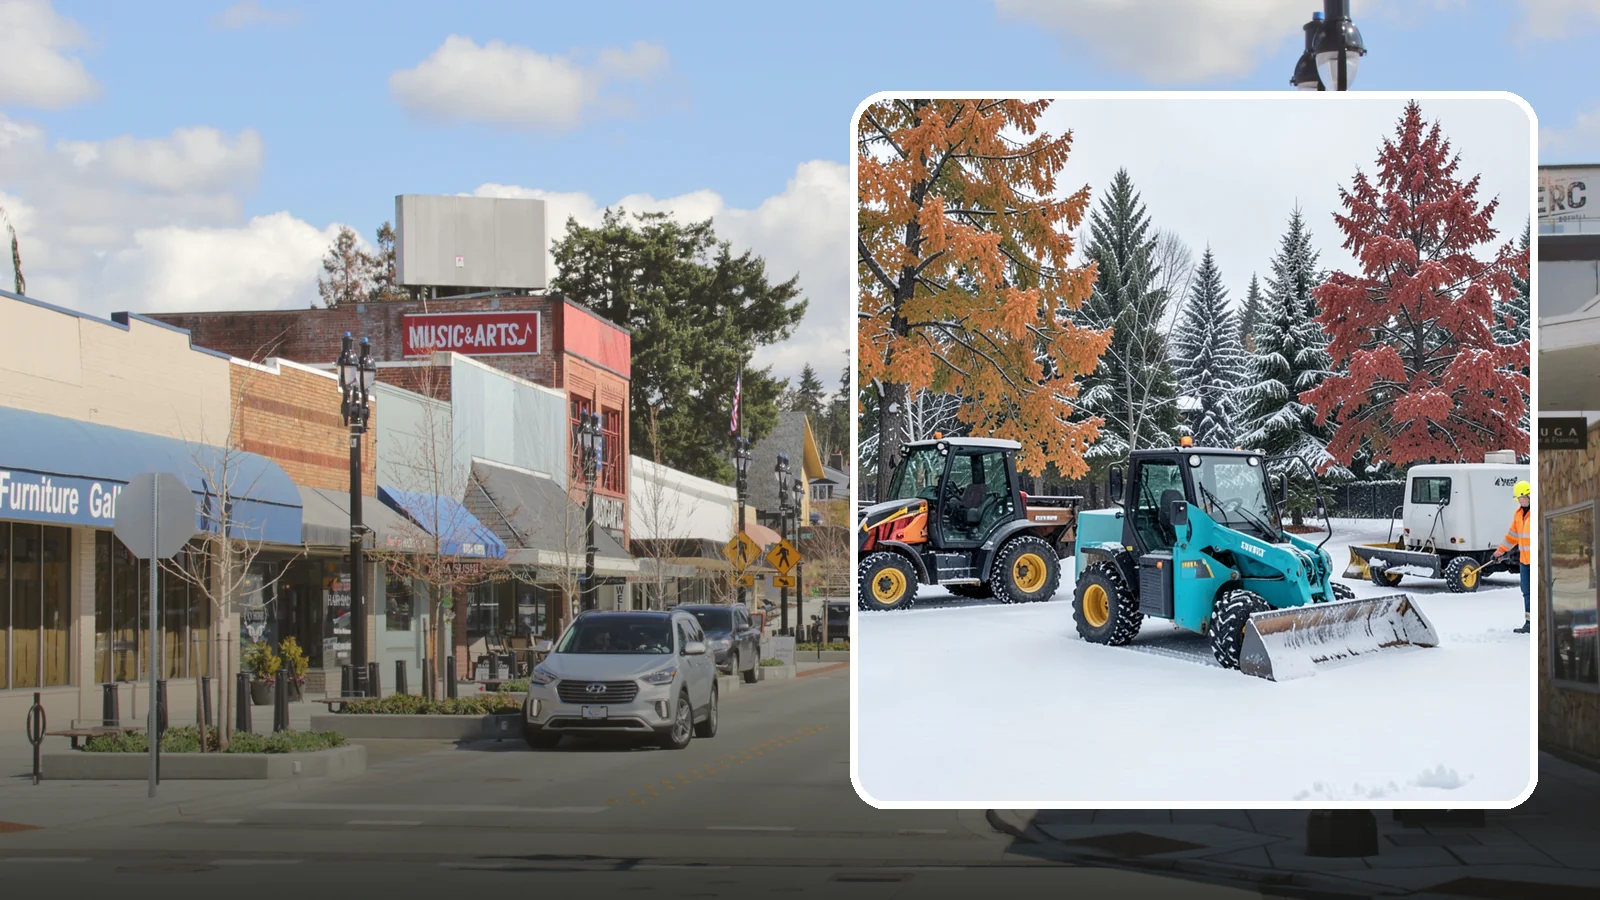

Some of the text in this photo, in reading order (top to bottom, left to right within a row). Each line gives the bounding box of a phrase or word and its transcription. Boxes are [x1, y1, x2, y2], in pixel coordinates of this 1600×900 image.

[1540, 428, 1577, 436] UGA
[0, 471, 121, 519] Furniture Gal
[453, 563, 479, 574] SUSHI
